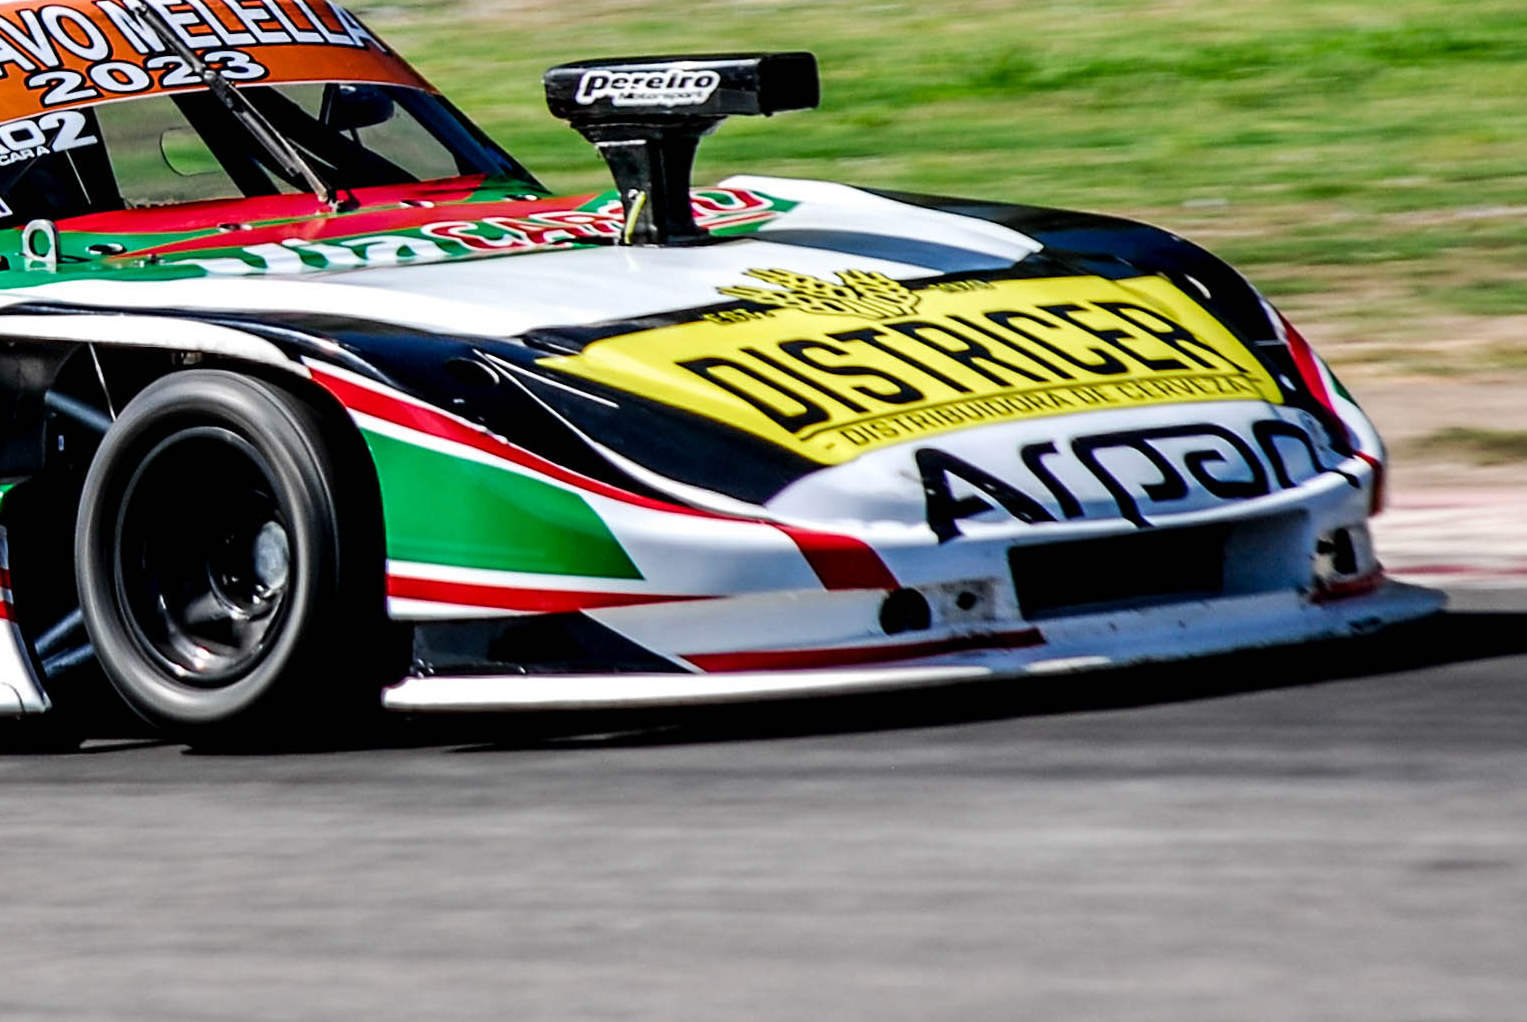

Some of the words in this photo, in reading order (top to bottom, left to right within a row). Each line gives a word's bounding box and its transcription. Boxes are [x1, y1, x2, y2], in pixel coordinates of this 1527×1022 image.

[26, 48, 269, 108] 2023
[581, 71, 715, 97] pereiro
[674, 300, 1250, 434] DISTRICER
[839, 391, 1065, 446] DISTRIBUIDORA
